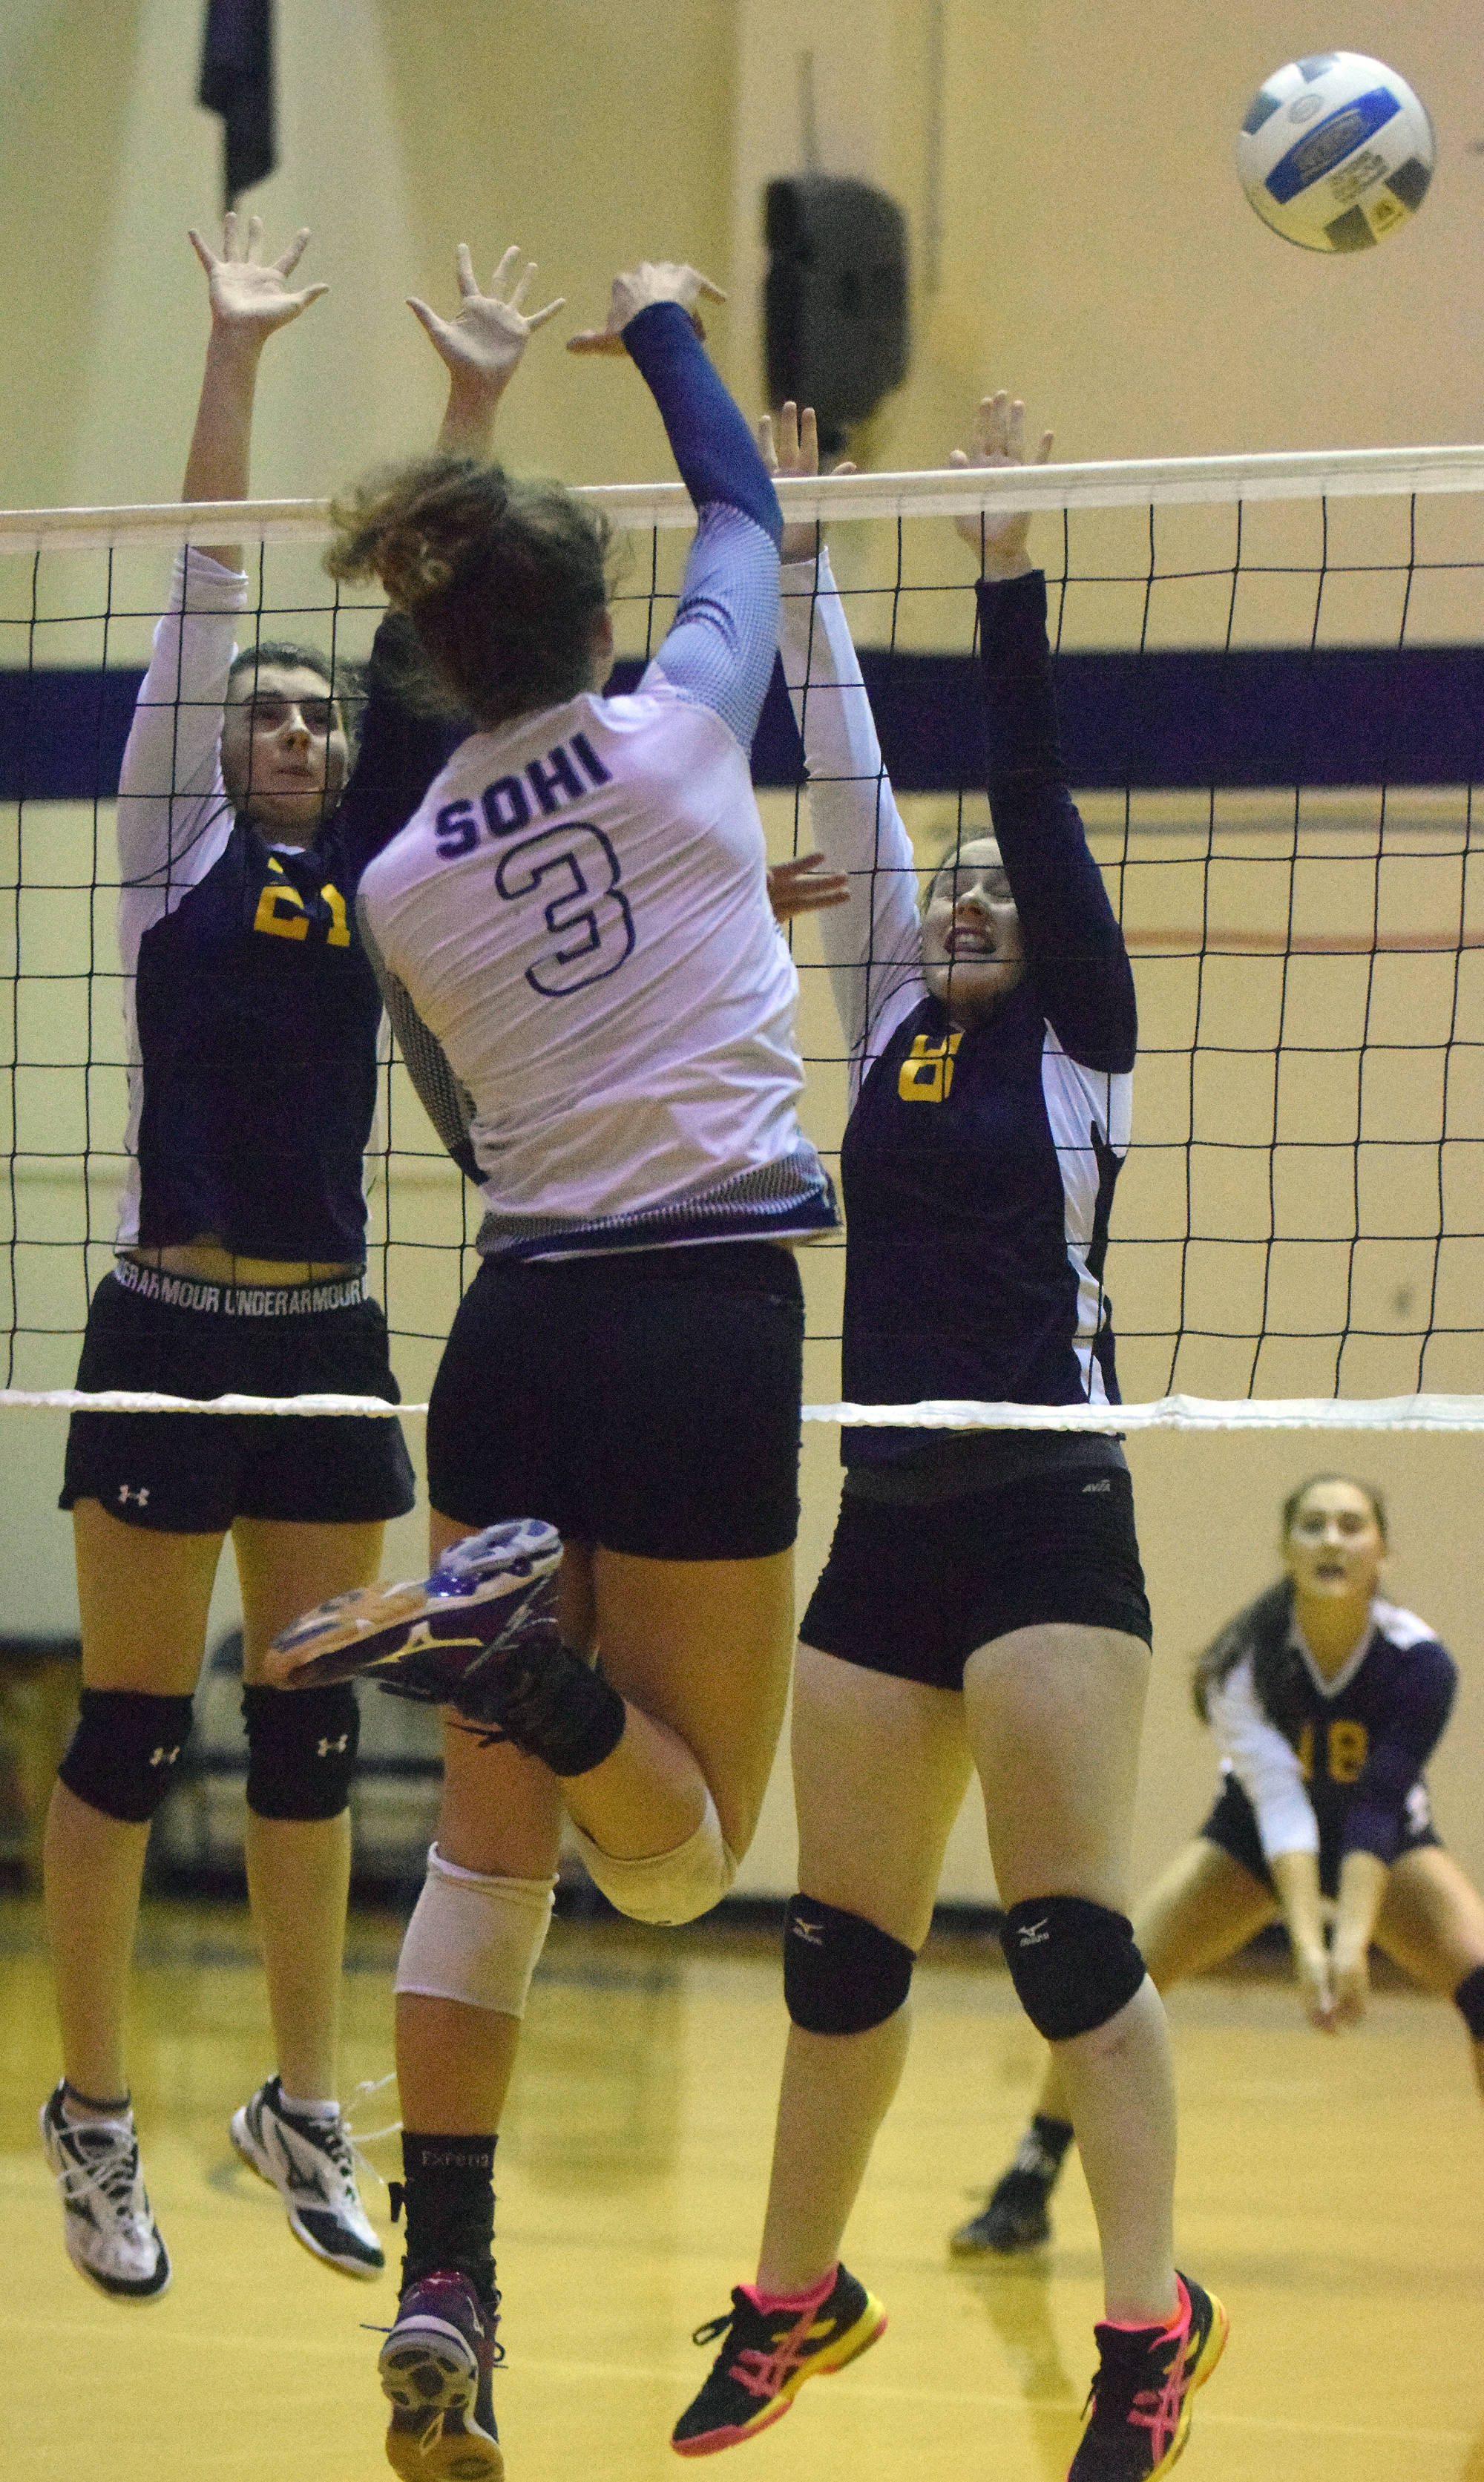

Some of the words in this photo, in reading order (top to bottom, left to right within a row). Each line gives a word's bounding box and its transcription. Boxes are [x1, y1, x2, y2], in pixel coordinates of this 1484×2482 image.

[436, 731, 614, 858] SOHI
[254, 856, 351, 948] 21
[495, 821, 637, 997] 3
[1297, 1717, 1368, 1784] 18
